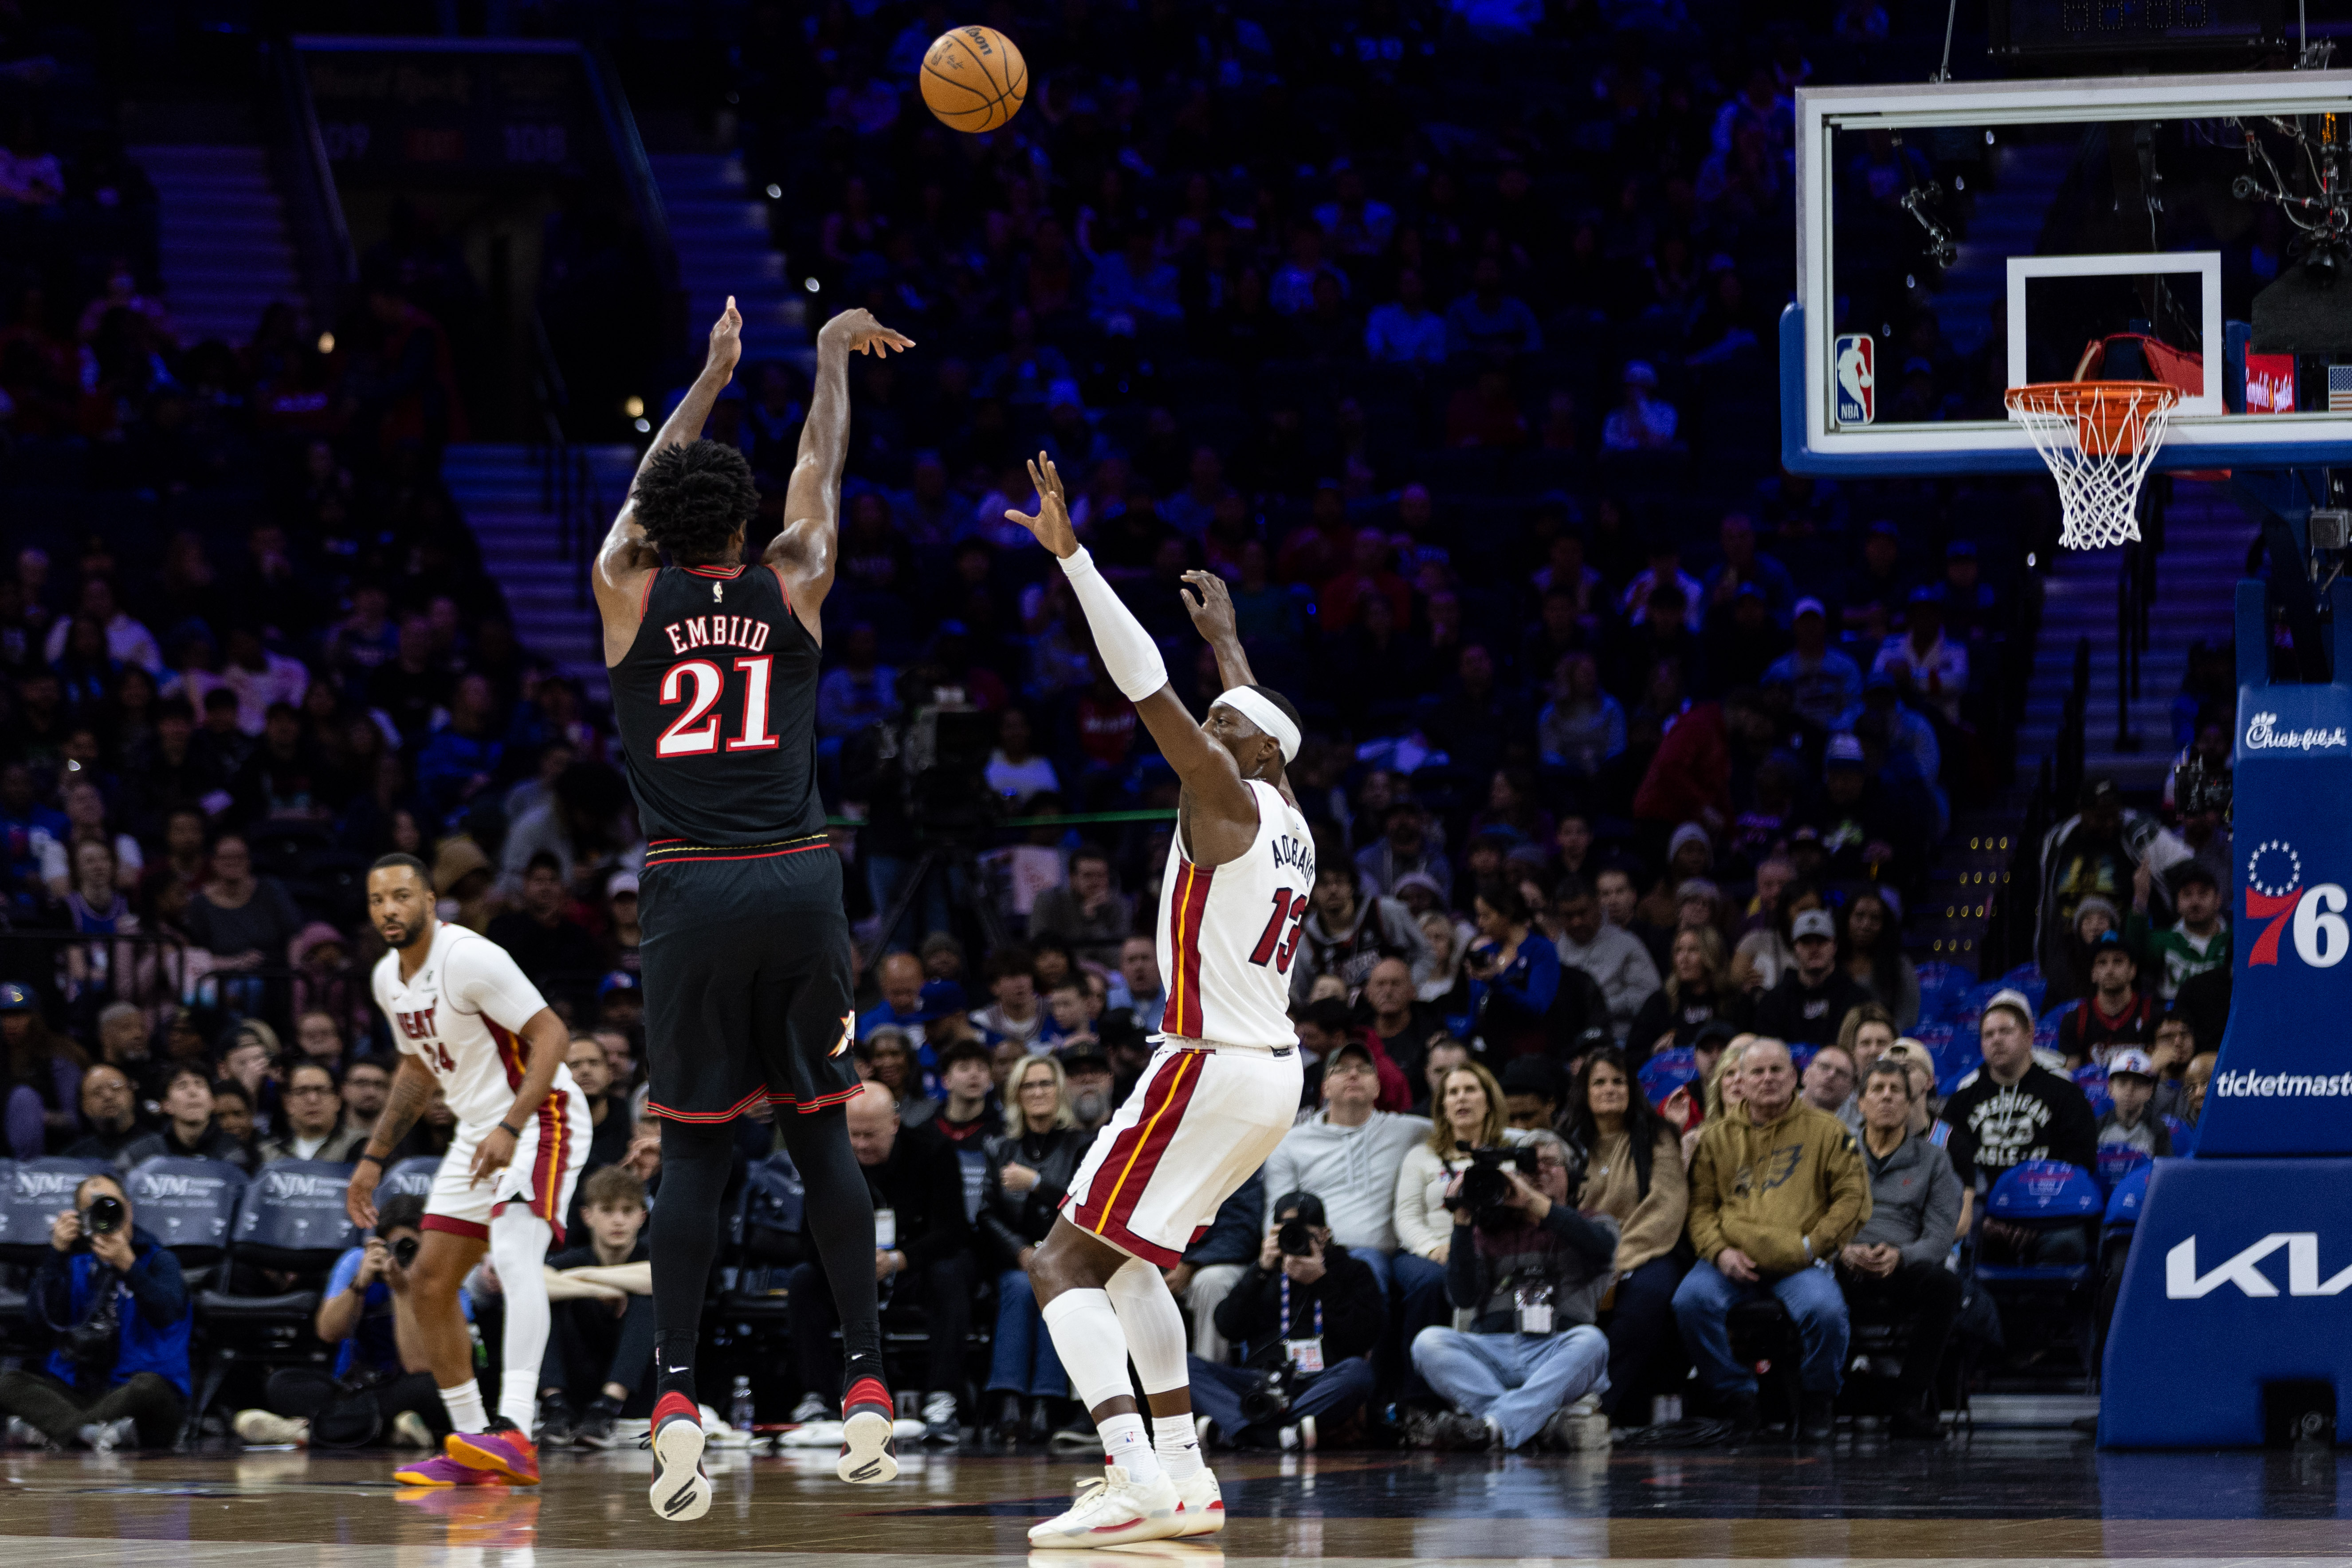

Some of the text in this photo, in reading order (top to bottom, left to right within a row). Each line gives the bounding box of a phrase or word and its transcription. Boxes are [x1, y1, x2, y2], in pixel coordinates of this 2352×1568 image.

[962, 27, 993, 56] lson
[1841, 403, 1859, 420] NBA
[665, 614, 770, 656] EMBIID
[656, 654, 780, 759] 21
[2246, 711, 2347, 751] Chick-fil-A
[1272, 834, 1314, 888] ADBAYO
[1248, 887, 1308, 975] 13
[2245, 882, 2350, 968] 76
[2217, 1068, 2352, 1097] ticketmast
[140, 1173, 190, 1199] NJM
[267, 1171, 316, 1199] NJM
